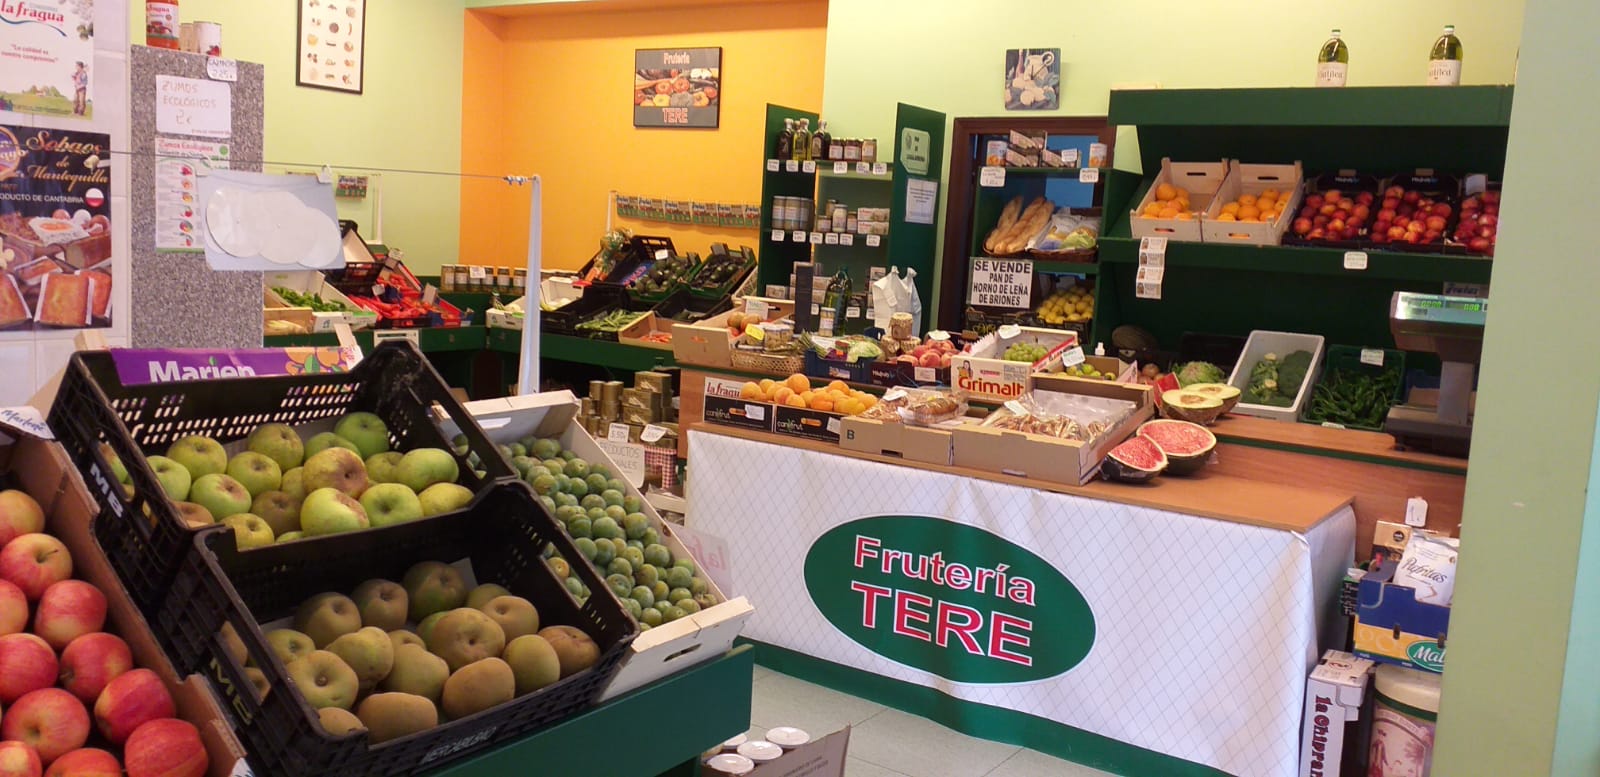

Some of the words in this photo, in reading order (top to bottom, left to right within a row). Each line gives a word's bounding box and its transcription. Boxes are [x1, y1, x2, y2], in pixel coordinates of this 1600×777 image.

[16, 2, 64, 22] fragua
[662, 107, 689, 123] TERE
[26, 131, 103, 154] Sobaos
[56, 156, 69, 168] de
[44, 195, 84, 203] CANTABRIA
[975, 260, 988, 271] SE
[992, 261, 1031, 274] VENDE
[989, 273, 1002, 283] PAN
[1004, 274, 1013, 283] DE
[973, 283, 997, 293] HORNO
[999, 284, 1009, 294] DE
[1009, 283, 1028, 296] LEÑA
[979, 295, 988, 303] DE
[989, 296, 1020, 306] BRIONES
[716, 382, 741, 399] fragu
[958, 376, 1025, 397] Grimalt
[847, 429, 855, 440] B
[854, 534, 1037, 607] Frutería
[851, 580, 1033, 667] TERE
[1315, 694, 1334, 713] la
